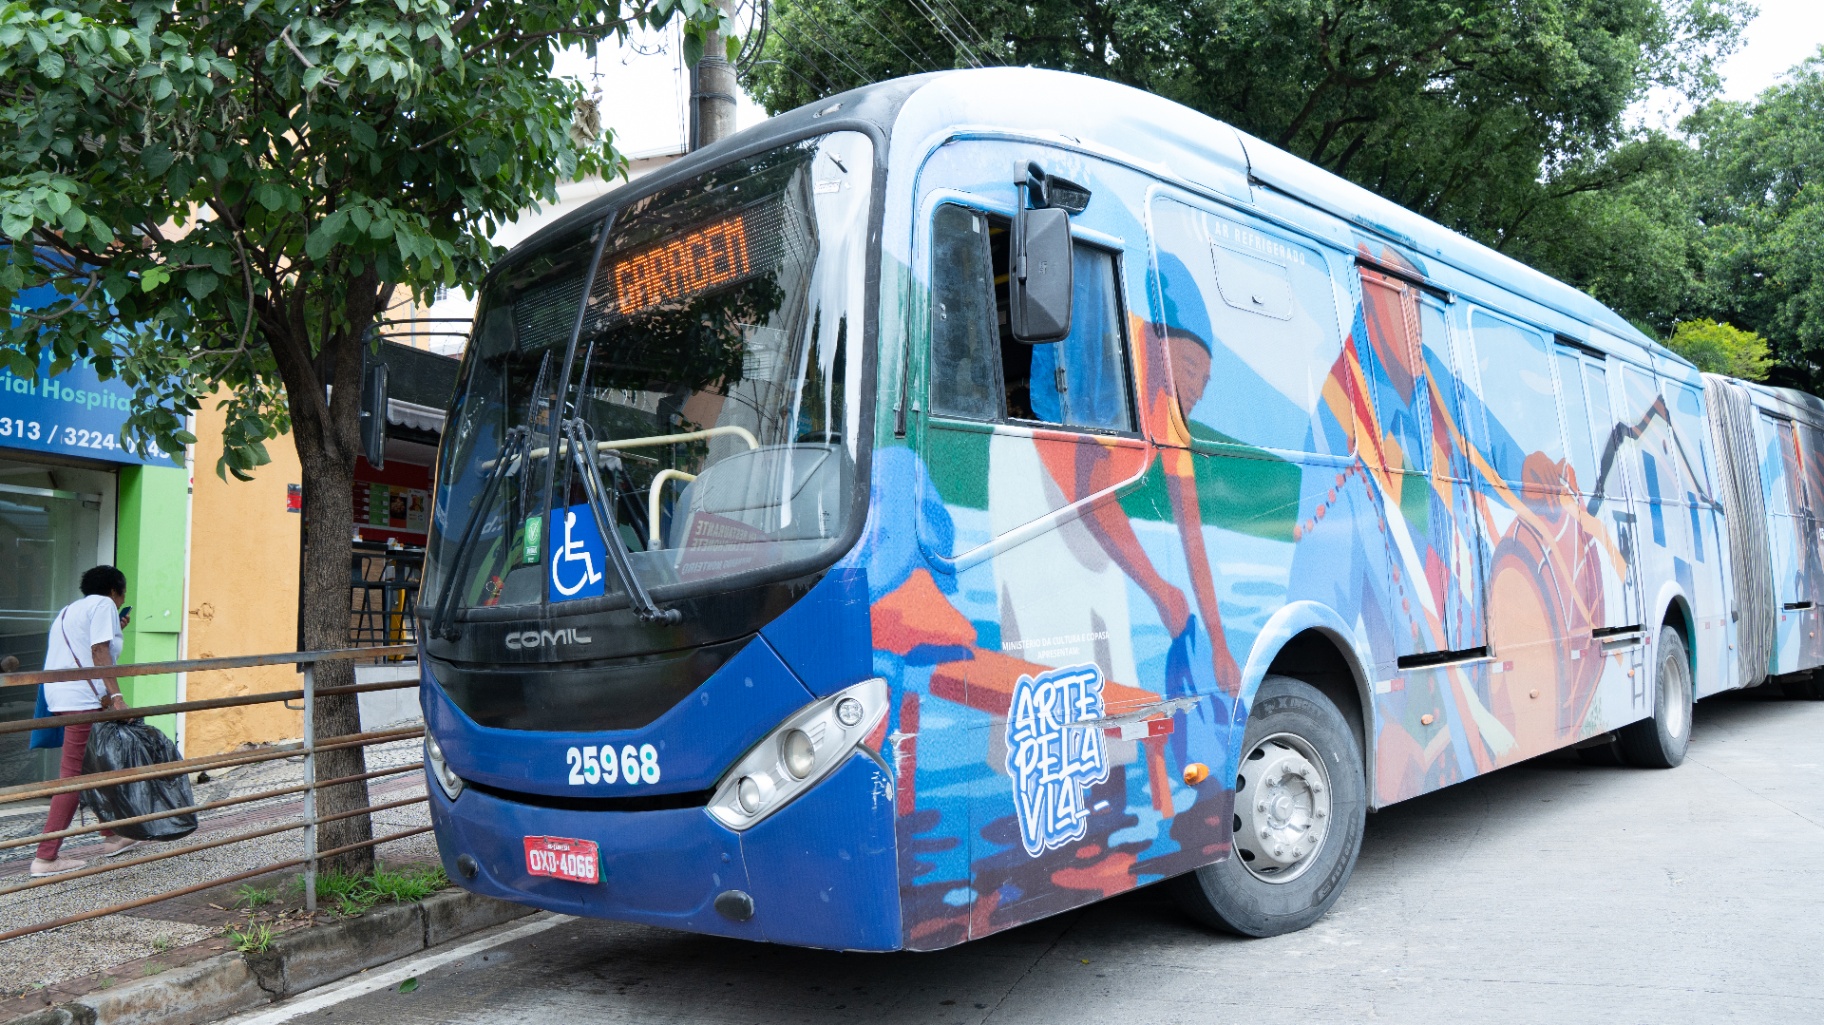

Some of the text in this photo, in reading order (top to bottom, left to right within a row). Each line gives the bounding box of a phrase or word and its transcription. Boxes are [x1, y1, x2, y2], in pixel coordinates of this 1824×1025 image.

[1214, 221, 1306, 266] AR REFRIGERADO
[613, 215, 750, 315] GARAGEM
[0, 370, 36, 396] ial
[0, 416, 41, 441] 313
[505, 628, 593, 650] COMIL
[1002, 638, 1041, 651] MINISTÉRIO
[1042, 637, 1052, 647] DA
[1052, 634, 1081, 645] CULTURA
[1086, 631, 1110, 641] COPASA
[1014, 672, 1097, 738] ARTE
[566, 743, 661, 786] 25968
[1014, 725, 1102, 792] PELA
[529, 849, 596, 879] OXD-4066
